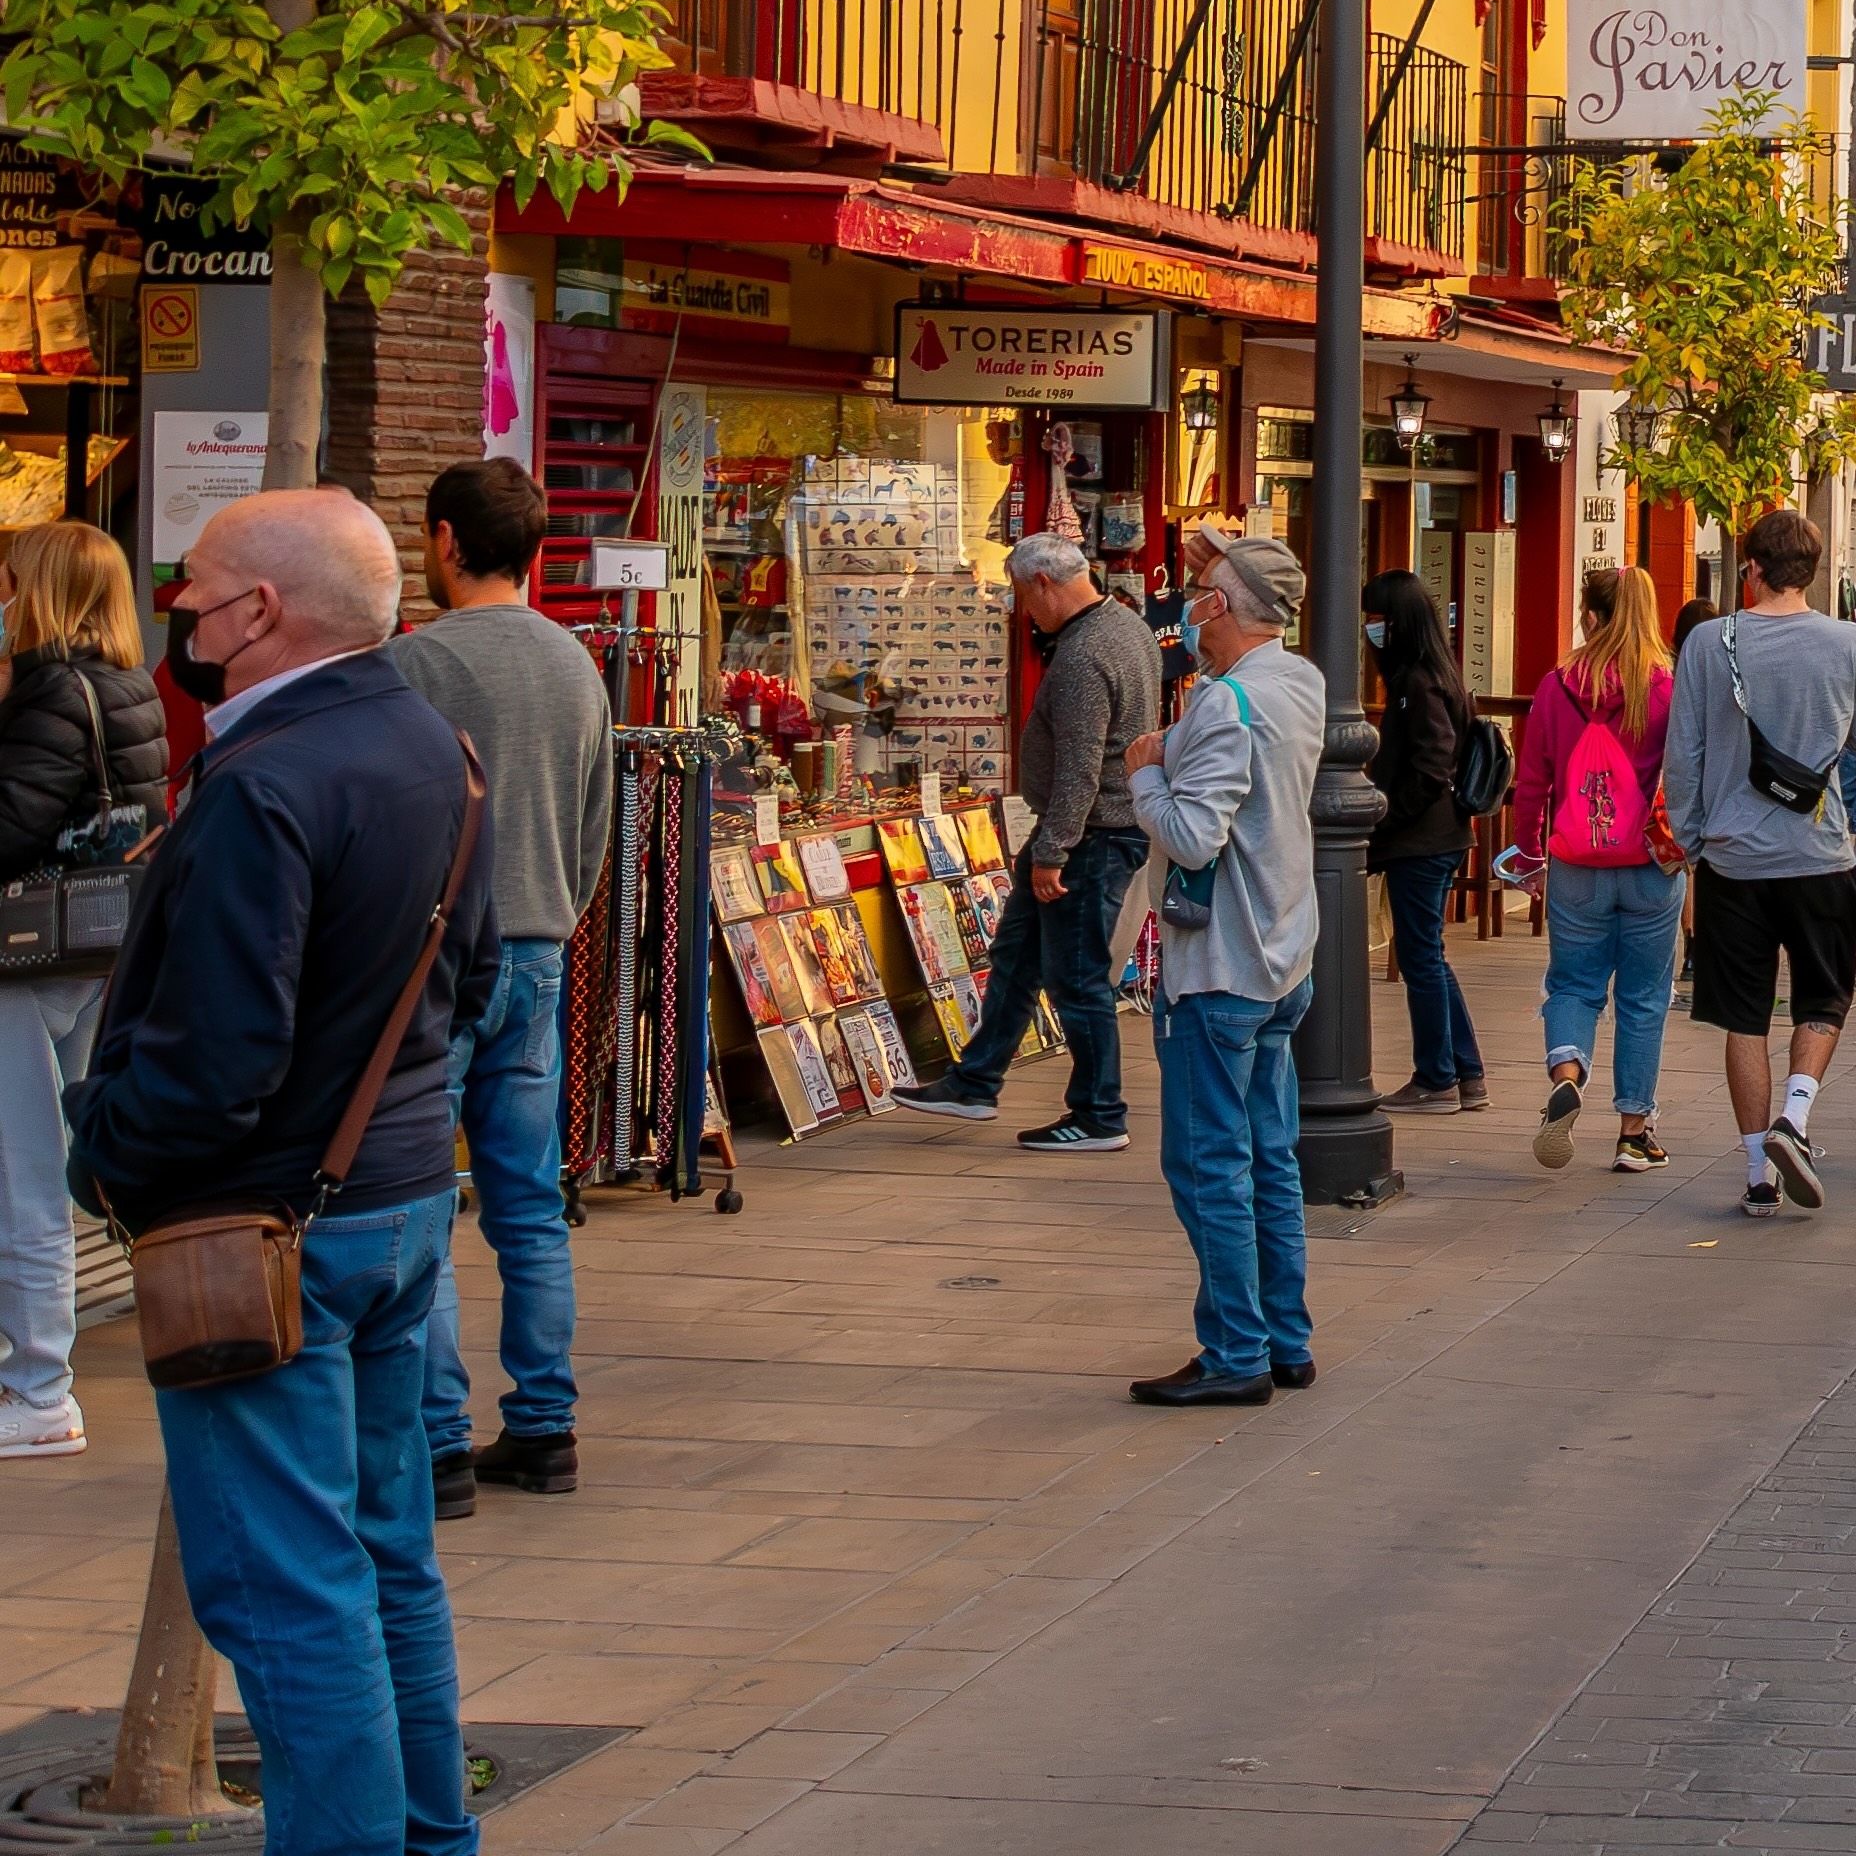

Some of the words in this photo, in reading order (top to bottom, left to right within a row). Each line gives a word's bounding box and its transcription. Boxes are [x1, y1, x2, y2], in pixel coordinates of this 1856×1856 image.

[1633, 8, 1711, 49] Don
[1578, 9, 1793, 124] Javier
[1085, 246, 1140, 288] 100%
[1143, 258, 1212, 300] ESPAÑOL
[736, 282, 770, 318] Civil
[948, 325, 1133, 356] TORERIAS
[975, 356, 1025, 377] Made
[1030, 357, 1048, 377] in
[1052, 359, 1105, 380] Spain
[1004, 385, 1042, 400] Desde
[1046, 387, 1074, 400] 1989
